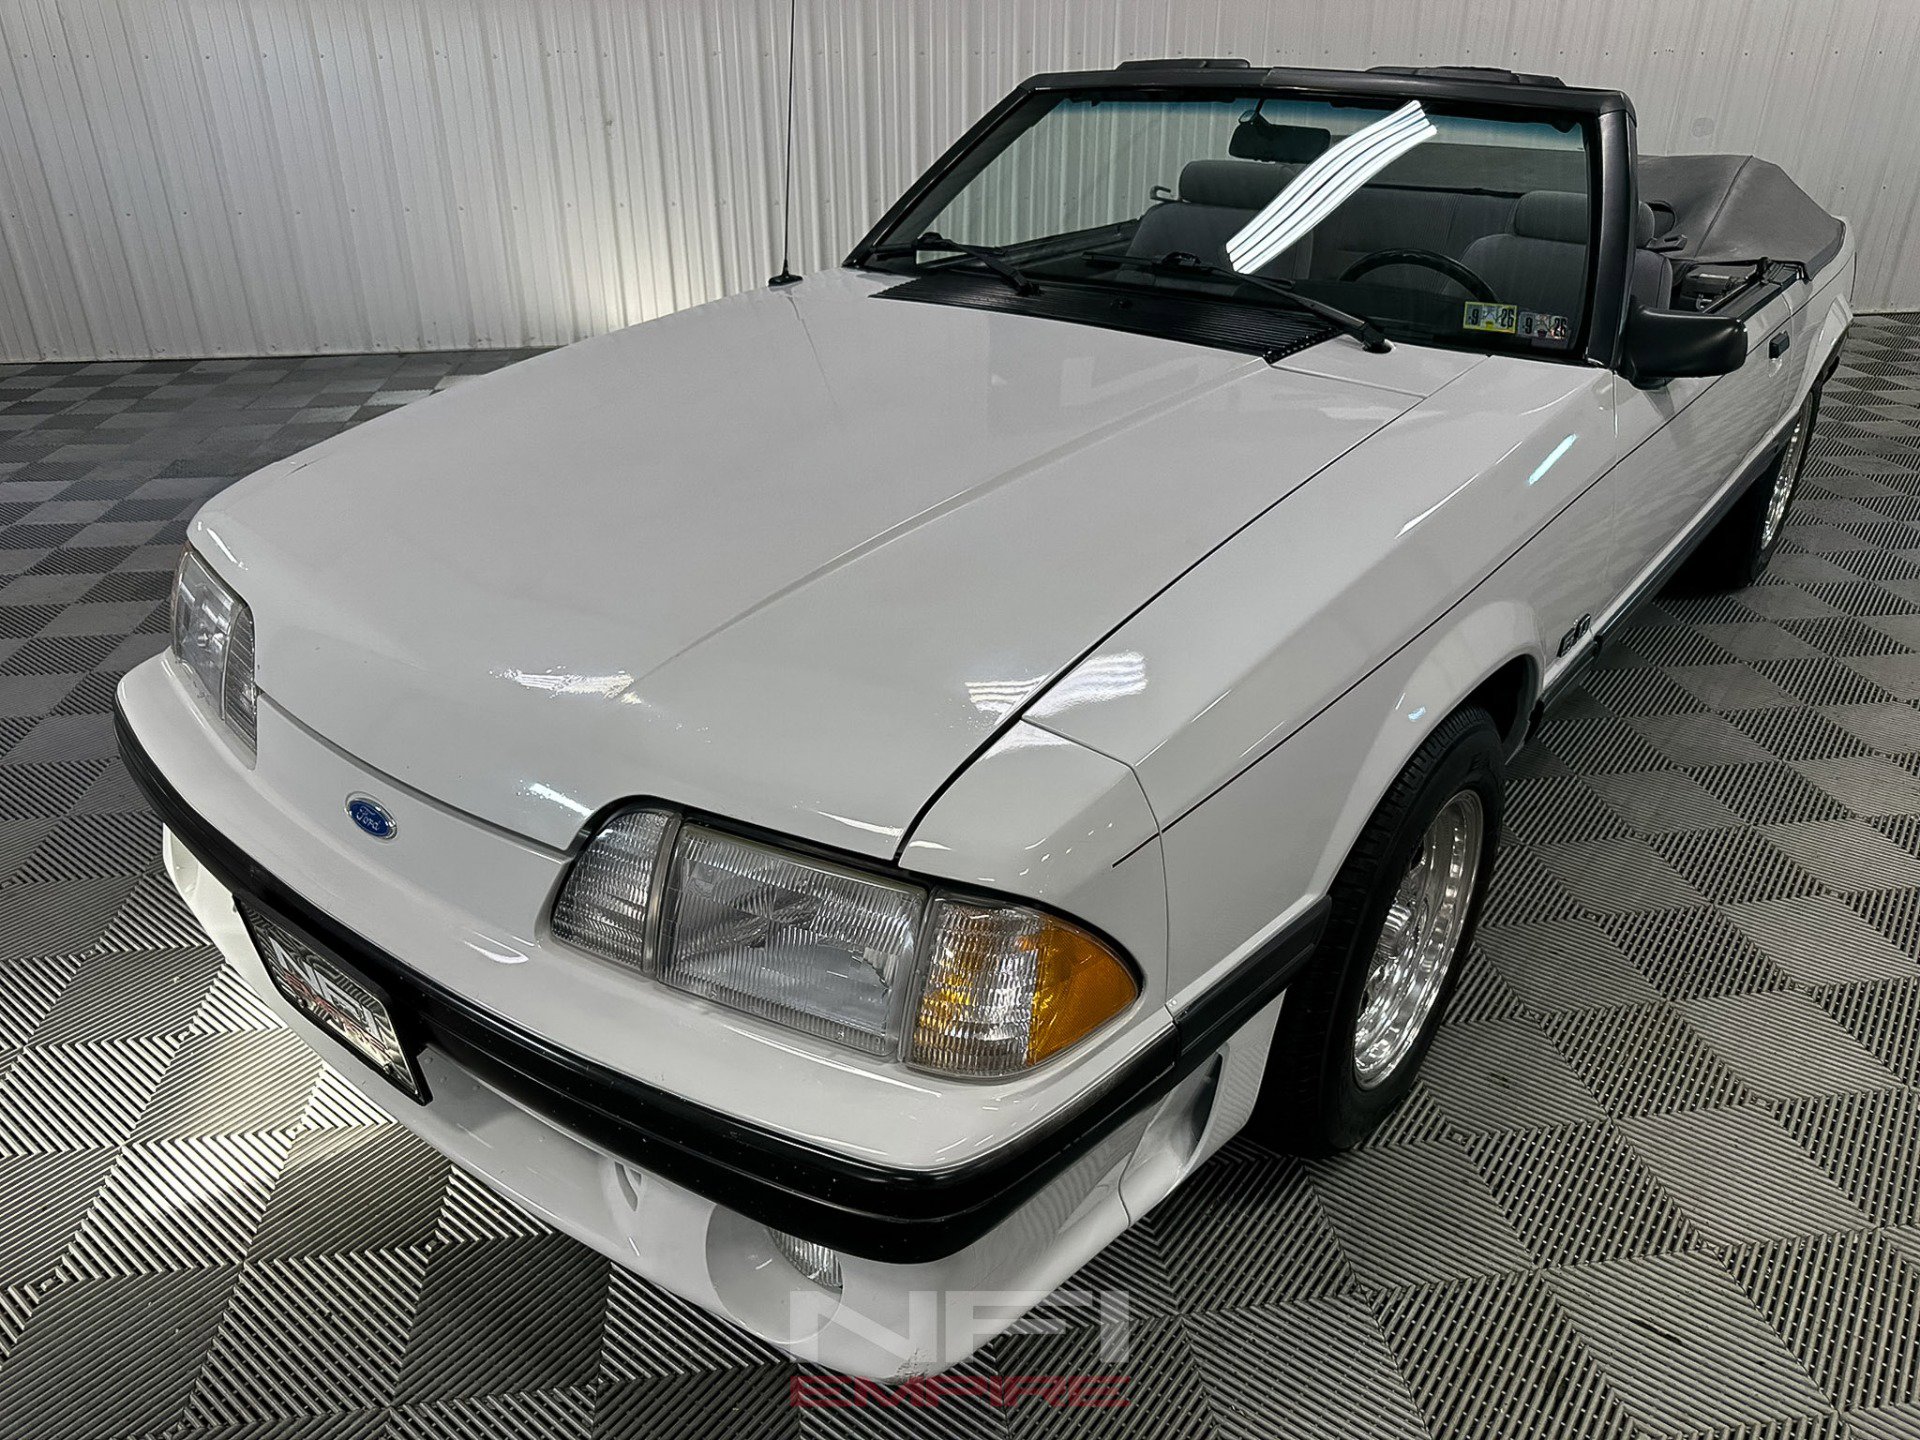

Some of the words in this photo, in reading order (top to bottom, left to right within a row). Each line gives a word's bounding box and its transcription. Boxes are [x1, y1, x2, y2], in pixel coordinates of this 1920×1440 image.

[1471, 308, 1479, 326] 9
[1500, 308, 1514, 328] 26
[1525, 317, 1533, 335] 9
